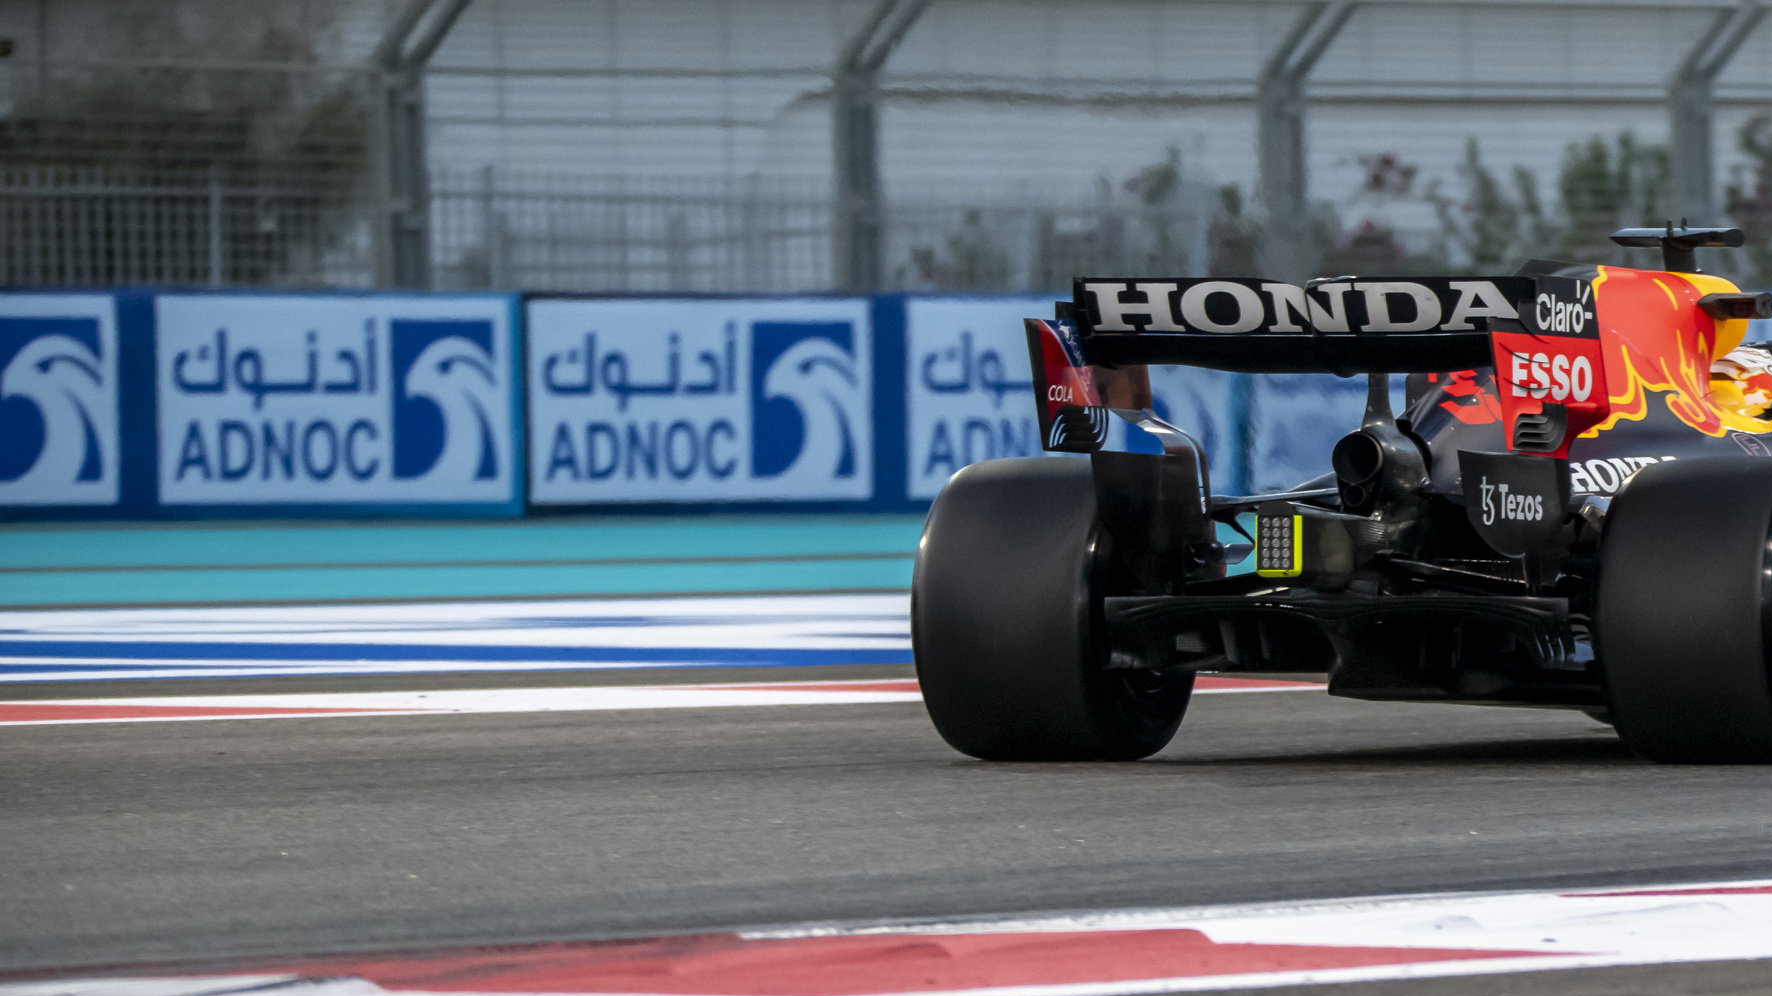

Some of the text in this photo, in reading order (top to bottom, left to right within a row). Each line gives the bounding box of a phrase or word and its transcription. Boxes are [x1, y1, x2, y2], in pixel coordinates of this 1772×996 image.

[1085, 280, 1519, 333] HONDA
[1536, 292, 1585, 334] Claro
[173, 318, 377, 411] أدنوك
[543, 320, 736, 413] أدنوك
[1511, 352, 1593, 402] ESSO
[1047, 384, 1073, 402] COLA
[175, 418, 380, 482] ADNOC
[545, 418, 738, 482] ADNOC
[1499, 484, 1543, 521] Tezos
